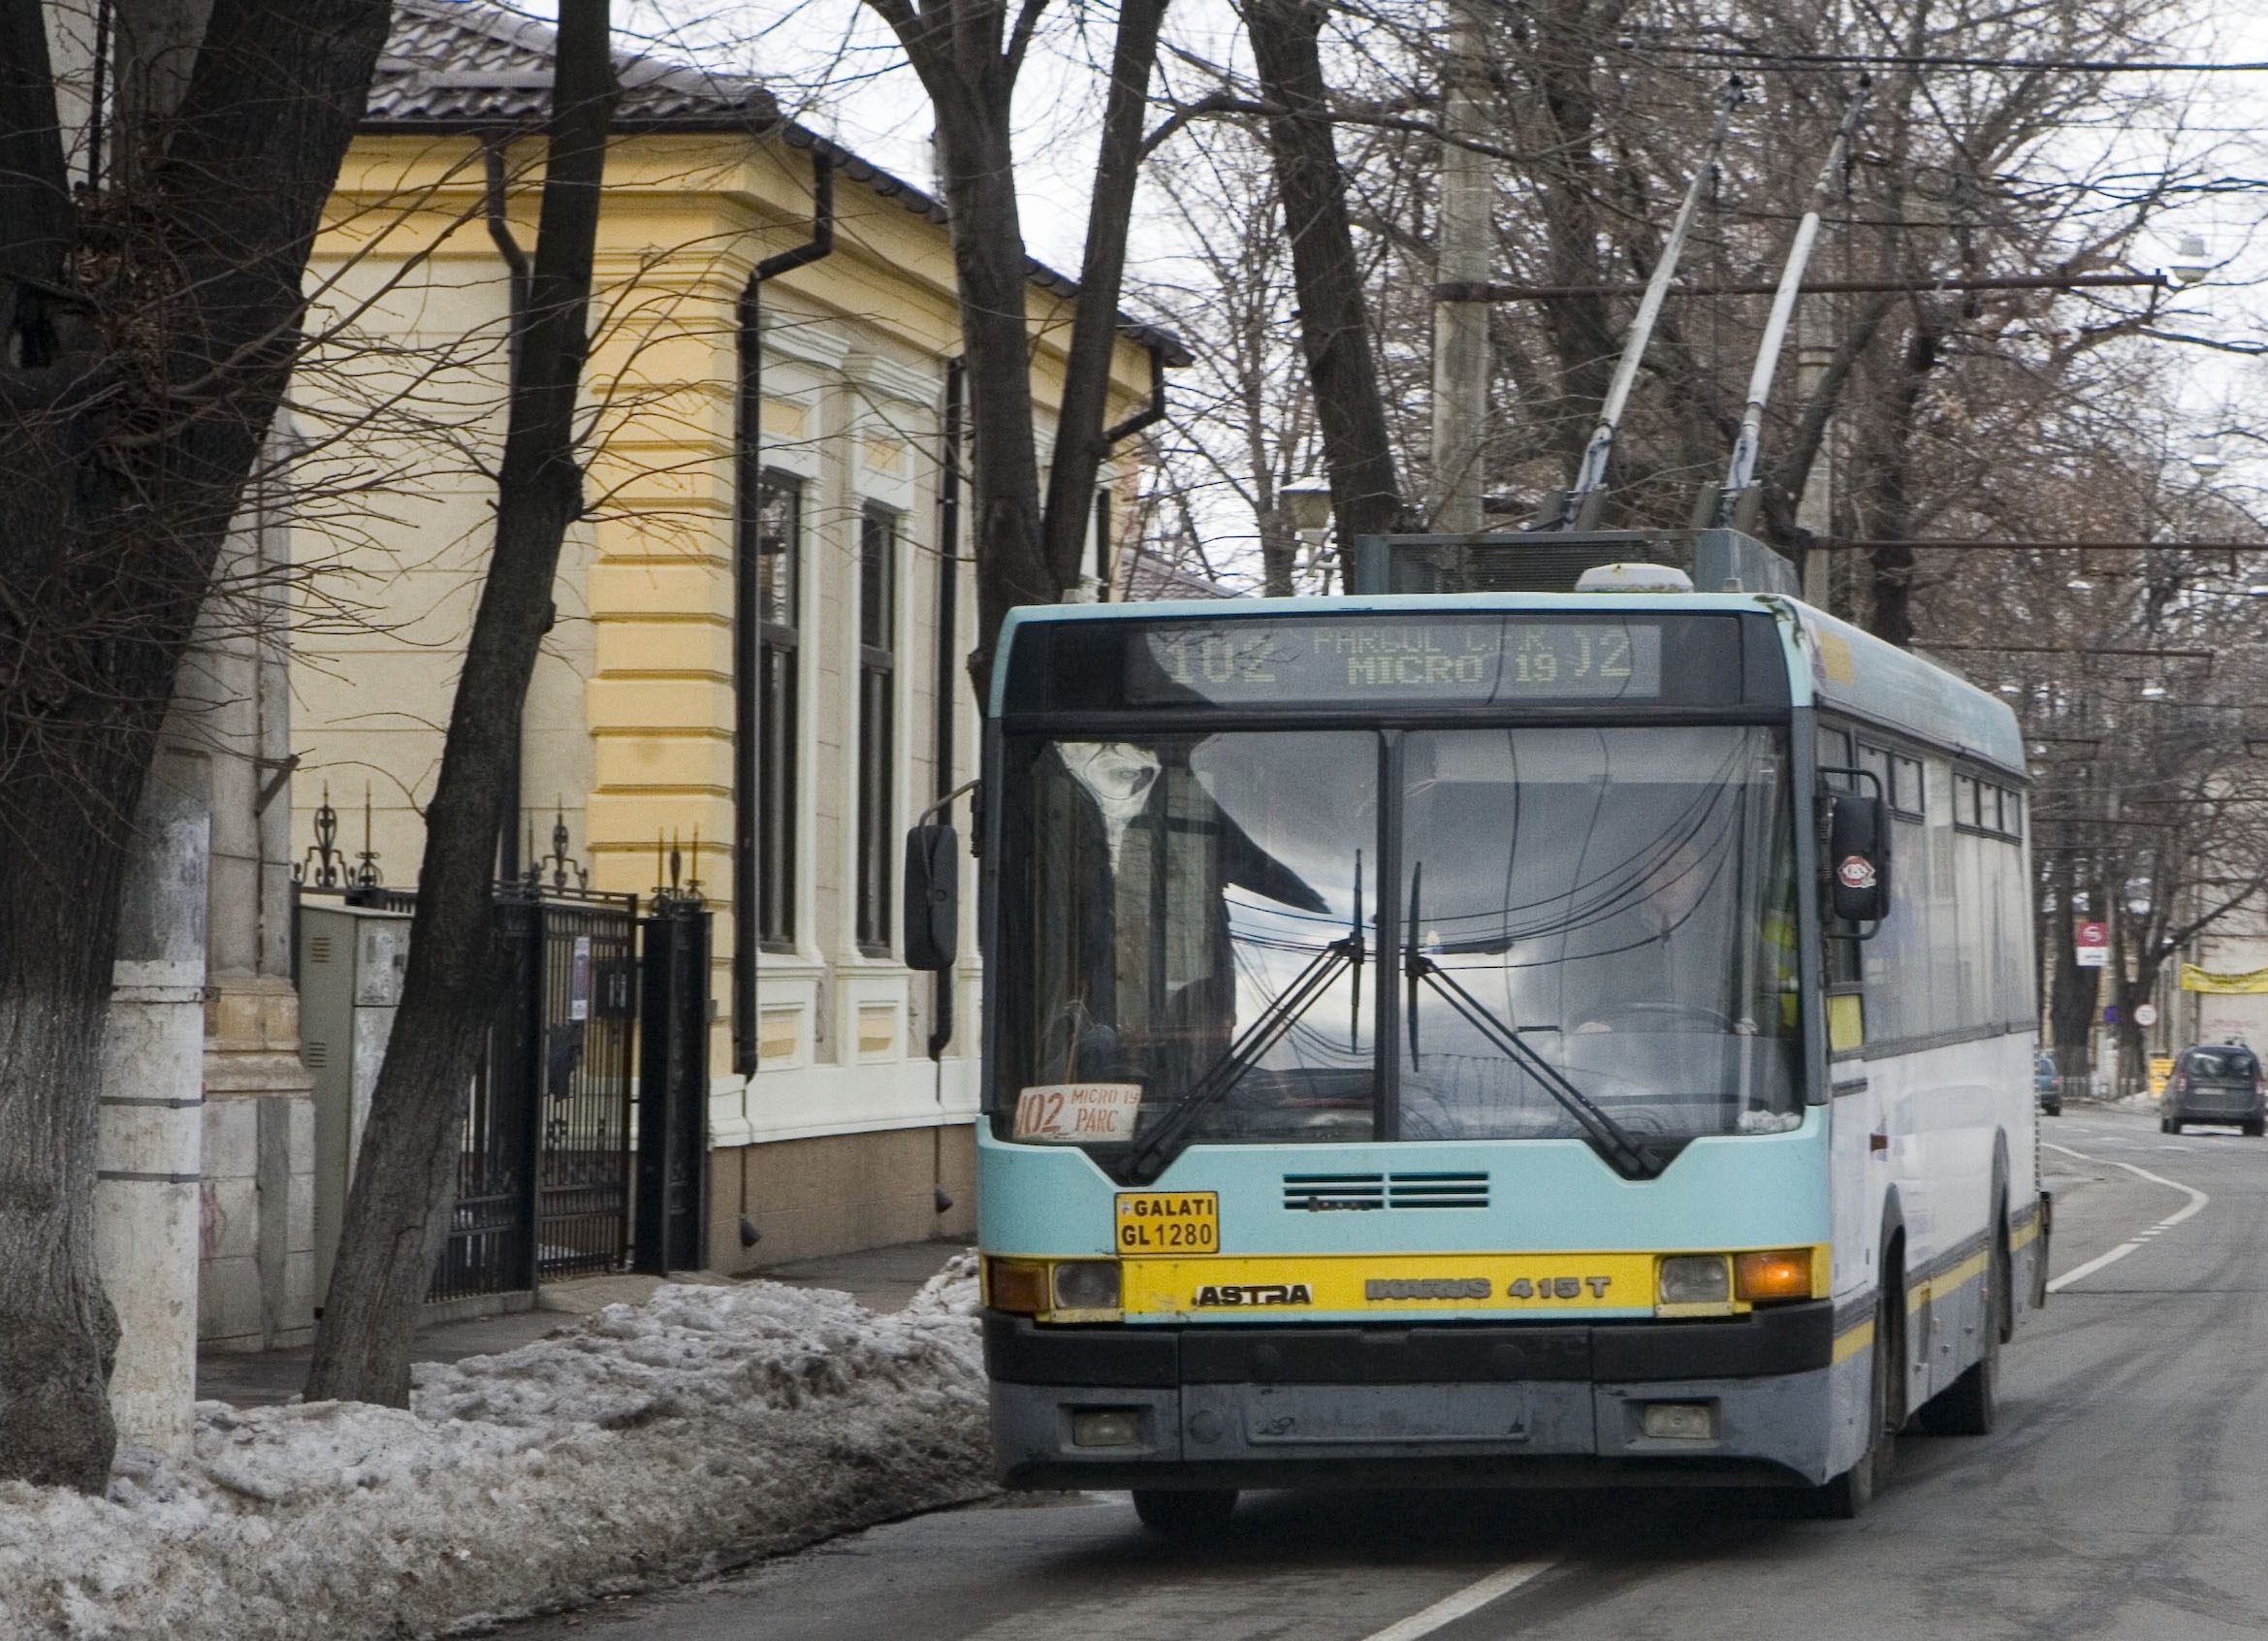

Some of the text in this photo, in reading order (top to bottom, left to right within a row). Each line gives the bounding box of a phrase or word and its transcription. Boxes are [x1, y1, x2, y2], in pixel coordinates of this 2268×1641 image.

[1166, 635, 1276, 683] 102
[1348, 653, 1558, 685] MICRO 19
[1070, 1087, 1139, 1106] MICRO 19
[1018, 1092, 1066, 1135] 102
[1075, 1108, 1119, 1133] PARC
[1134, 1198, 1214, 1217] GALATI
[1121, 1223, 1213, 1246] GL 1280
[1198, 1283, 1312, 1305] ASTRA
